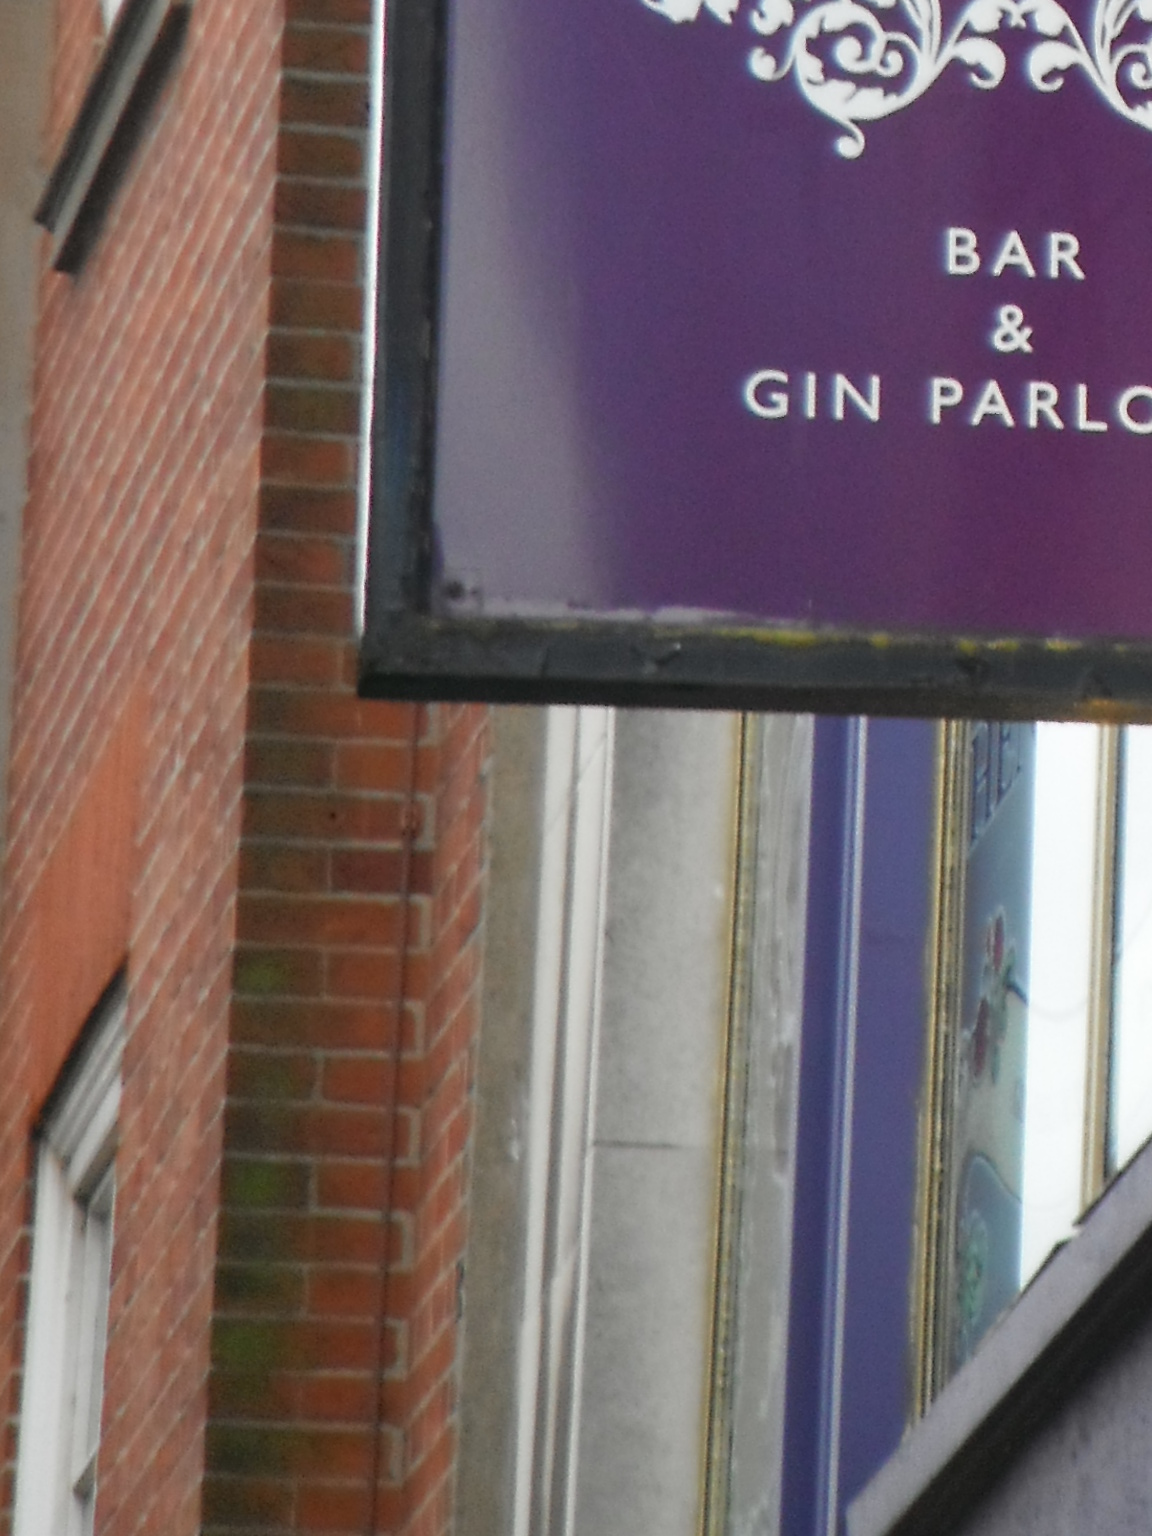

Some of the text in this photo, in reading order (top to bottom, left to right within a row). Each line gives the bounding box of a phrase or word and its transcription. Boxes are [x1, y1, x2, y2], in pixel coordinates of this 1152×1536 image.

[946, 227, 1086, 281] BAR
[992, 303, 1035, 354] &
[743, 368, 882, 423] GIN
